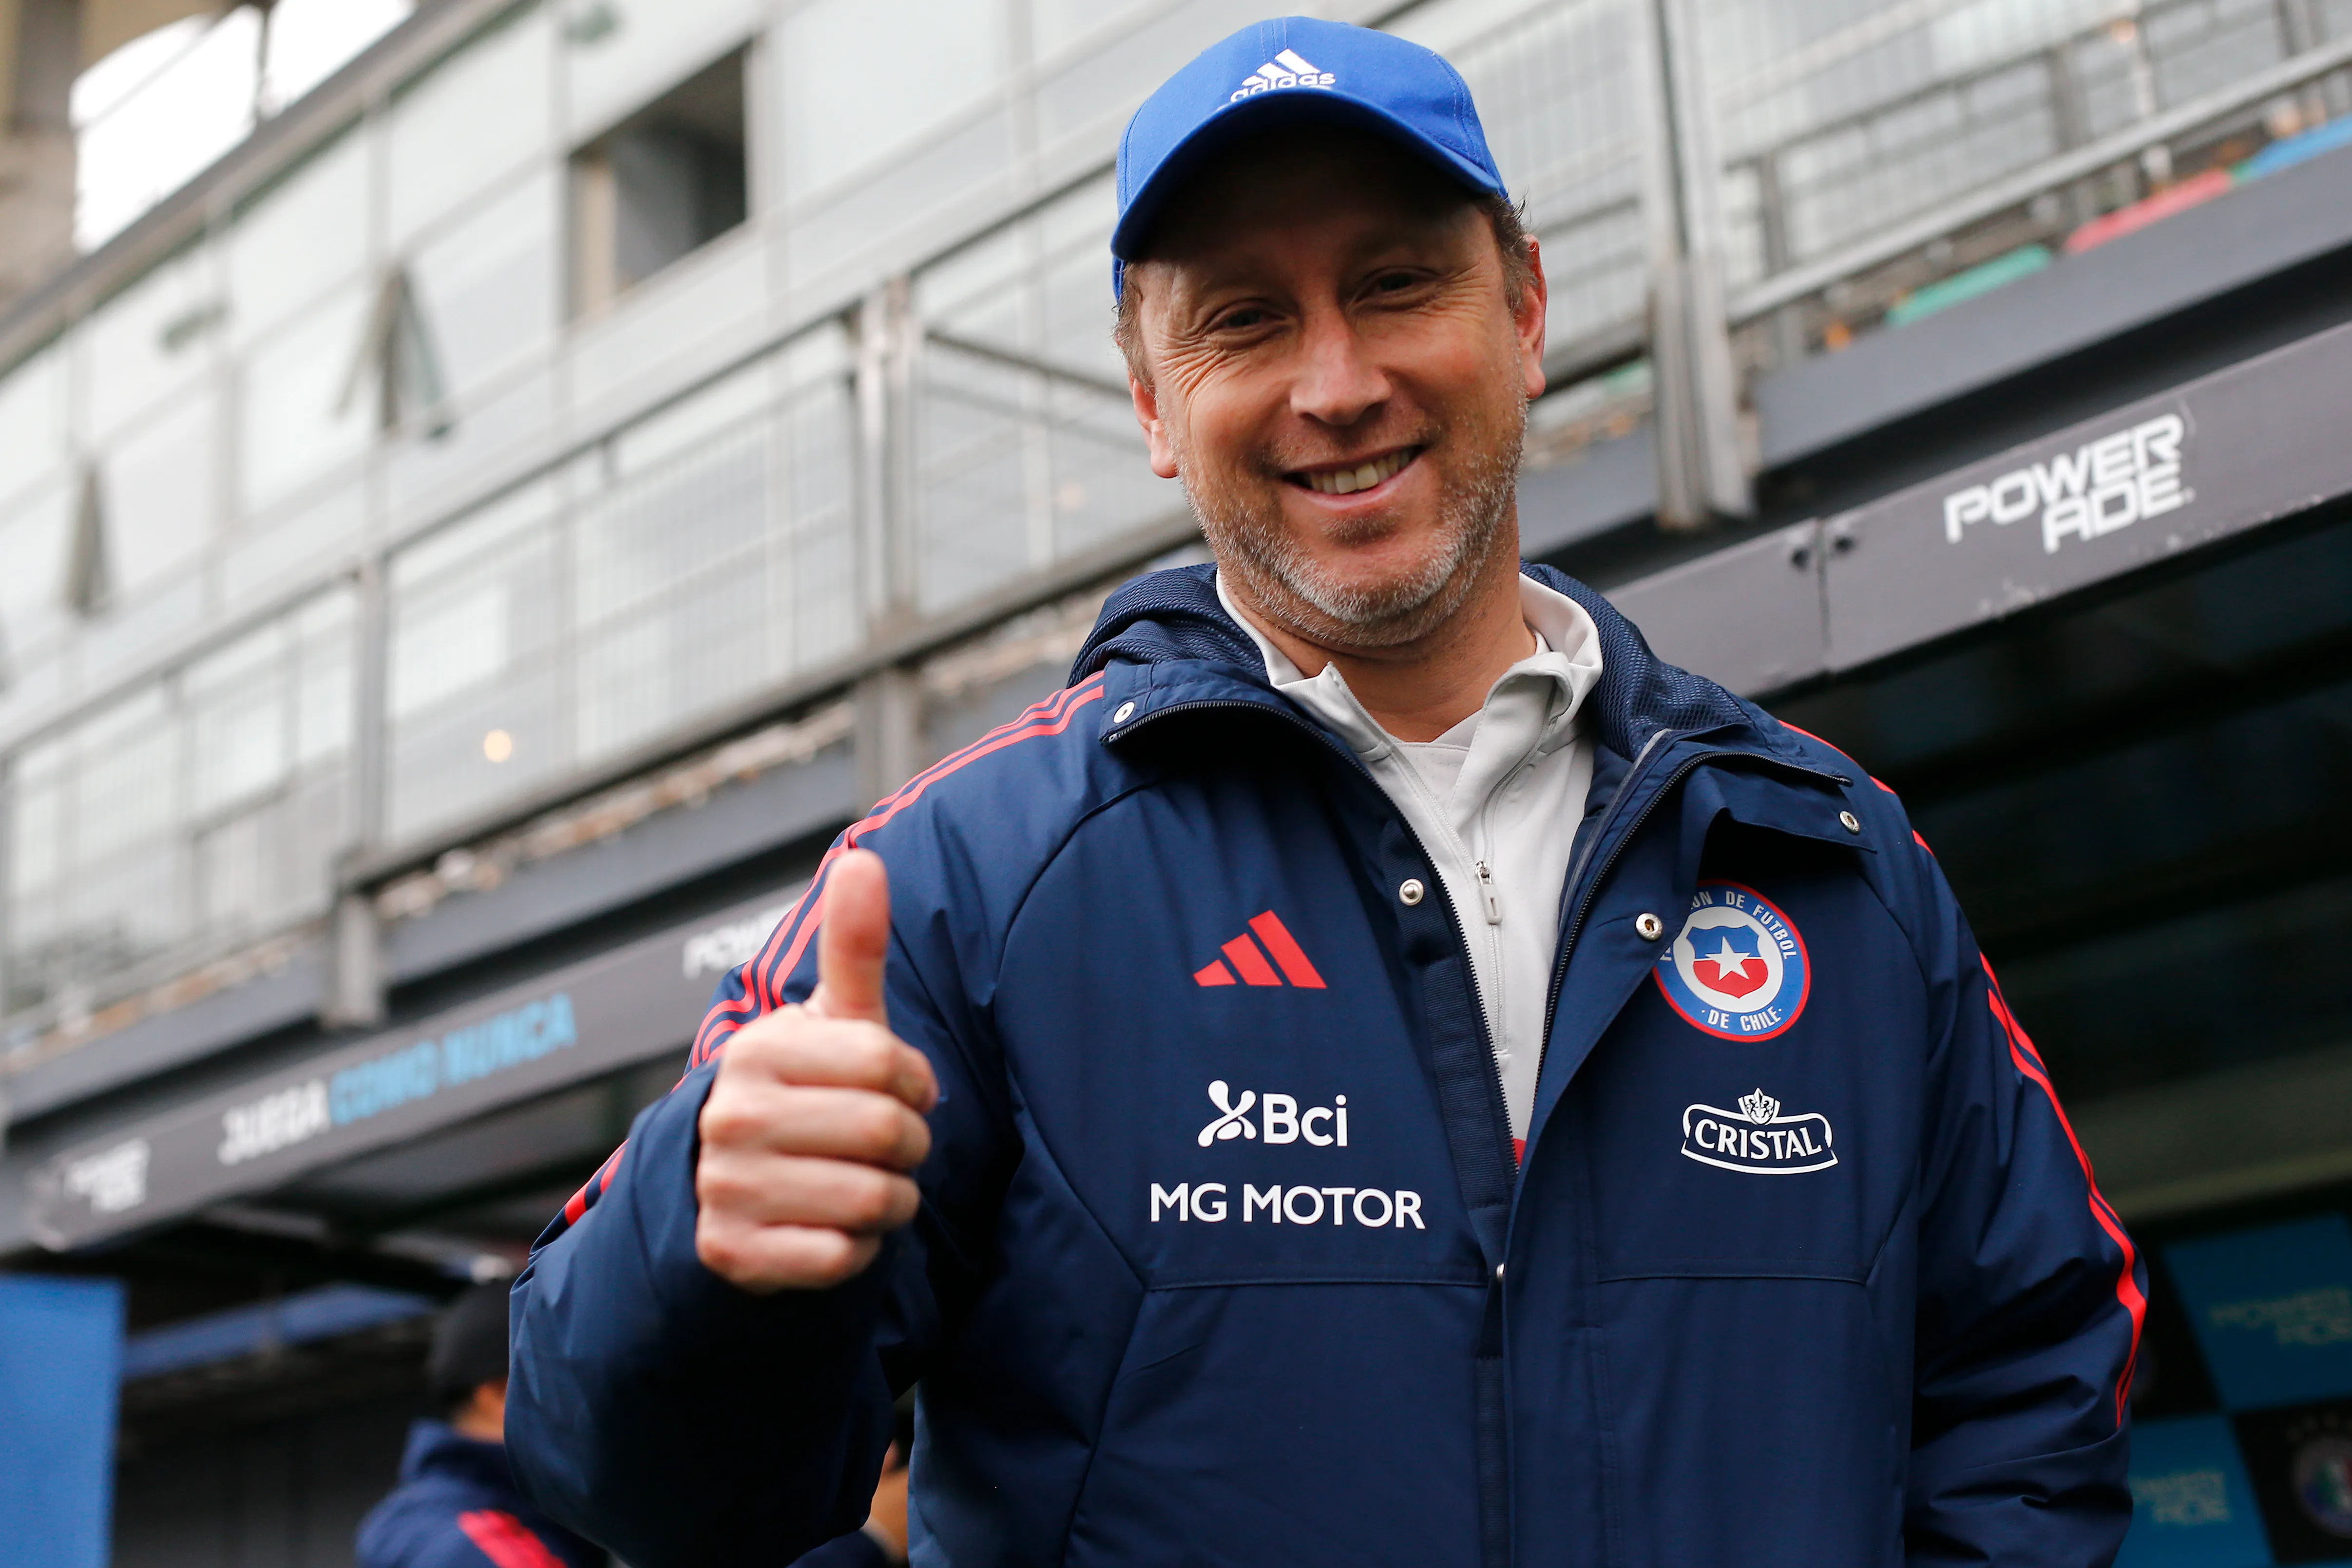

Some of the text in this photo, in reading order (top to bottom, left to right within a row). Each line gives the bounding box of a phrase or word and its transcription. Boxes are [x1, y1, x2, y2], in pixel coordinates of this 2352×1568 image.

[1230, 72, 1336, 103] adidas
[1944, 413, 2184, 544] POWER
[1725, 890, 1745, 909] DE
[1752, 904, 1797, 960] FUTBOL
[1707, 1005, 1781, 1032] DE CHILE
[1262, 1093, 1348, 1147] Bci
[1695, 1119, 1822, 1160] CRISTAL
[1150, 1182, 1426, 1229] MG MOTOR
